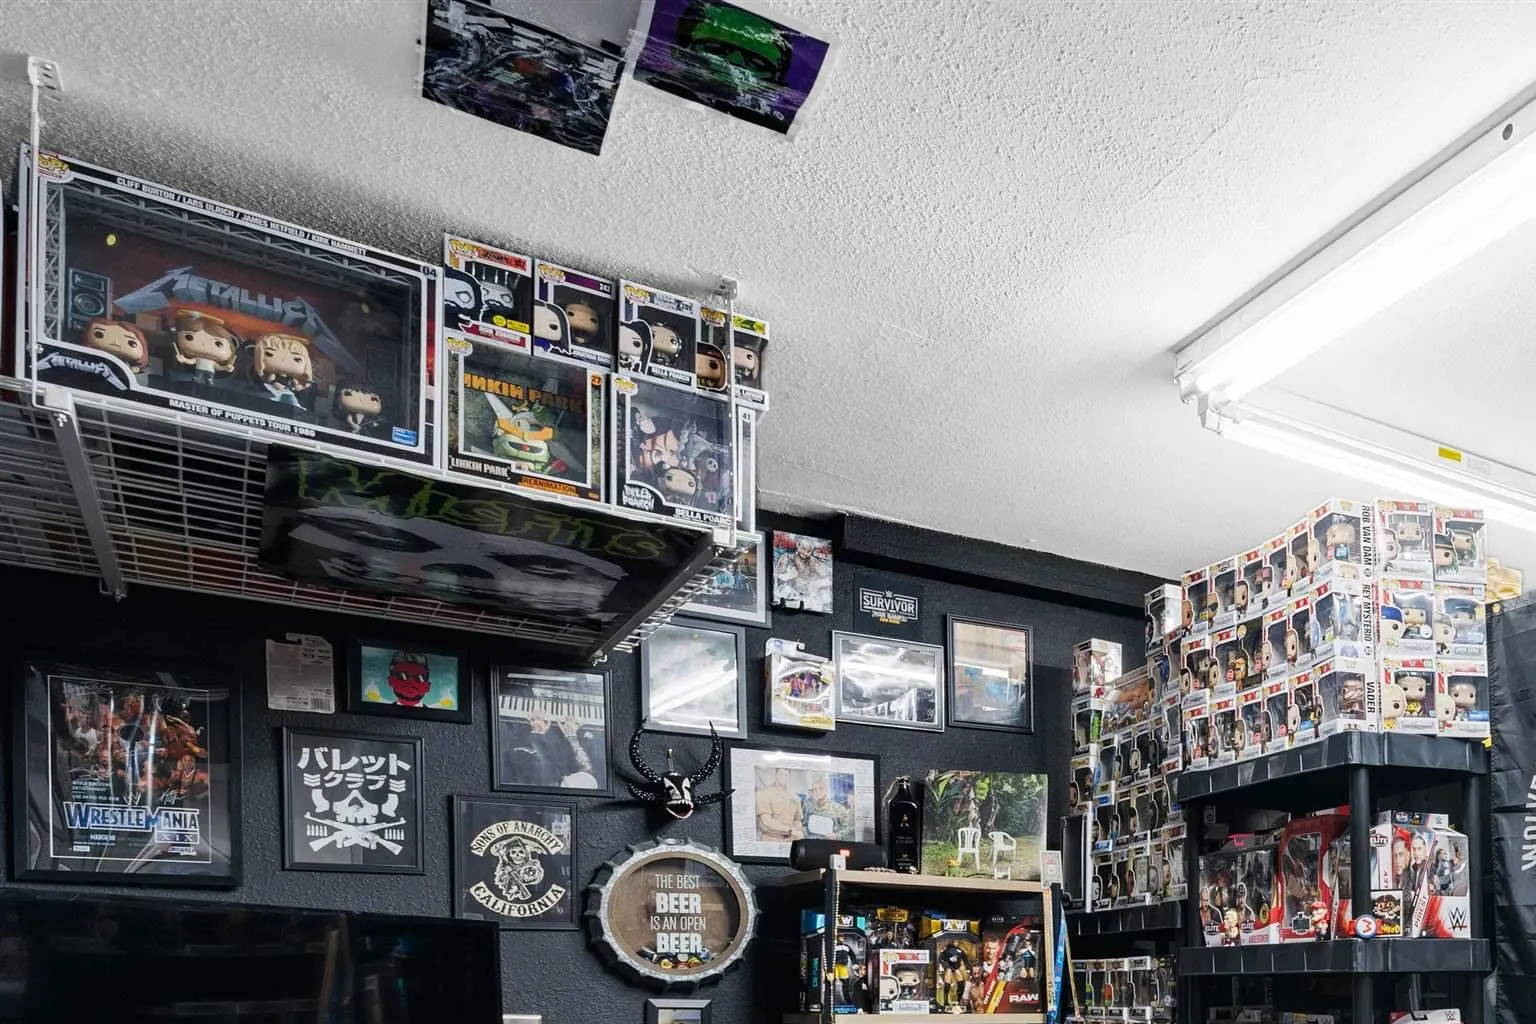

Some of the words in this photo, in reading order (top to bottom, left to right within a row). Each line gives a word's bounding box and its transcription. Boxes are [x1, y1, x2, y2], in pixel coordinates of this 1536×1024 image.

[116, 176, 140, 190] CLIFF
[141, 182, 176, 202] BURTON
[169, 398, 209, 415] MASTER
[210, 407, 224, 418] OF
[225, 410, 267, 428] PUPPETS
[267, 420, 292, 433] TOUR
[483, 463, 510, 478] PARK
[520, 476, 577, 495] REANIMATION
[674, 508, 702, 520] BELLA
[1362, 504, 1371, 523] ROB
[1362, 524, 1372, 543] VAN
[1362, 545, 1372, 568] DAM
[1362, 584, 1371, 599] REY
[863, 594, 915, 615] SURVIVOR
[1362, 601, 1372, 642] MYSTERIO
[1366, 681, 1375, 713] VADER
[297, 747, 412, 776] バレット
[323, 770, 388, 791] クラブ
[471, 829, 497, 853] SONS
[496, 822, 510, 834] OF
[513, 821, 561, 850] ANARCHY
[655, 873, 674, 889] THE
[676, 874, 701, 890] BEST
[473, 885, 564, 917] CALIFORNIA
[655, 892, 702, 914] BEER
[650, 915, 661, 931] IS
[662, 916, 677, 931] AN
[680, 916, 706, 931] OPEN
[656, 932, 703, 954] BEER
[1008, 993, 1040, 1004] RAW
